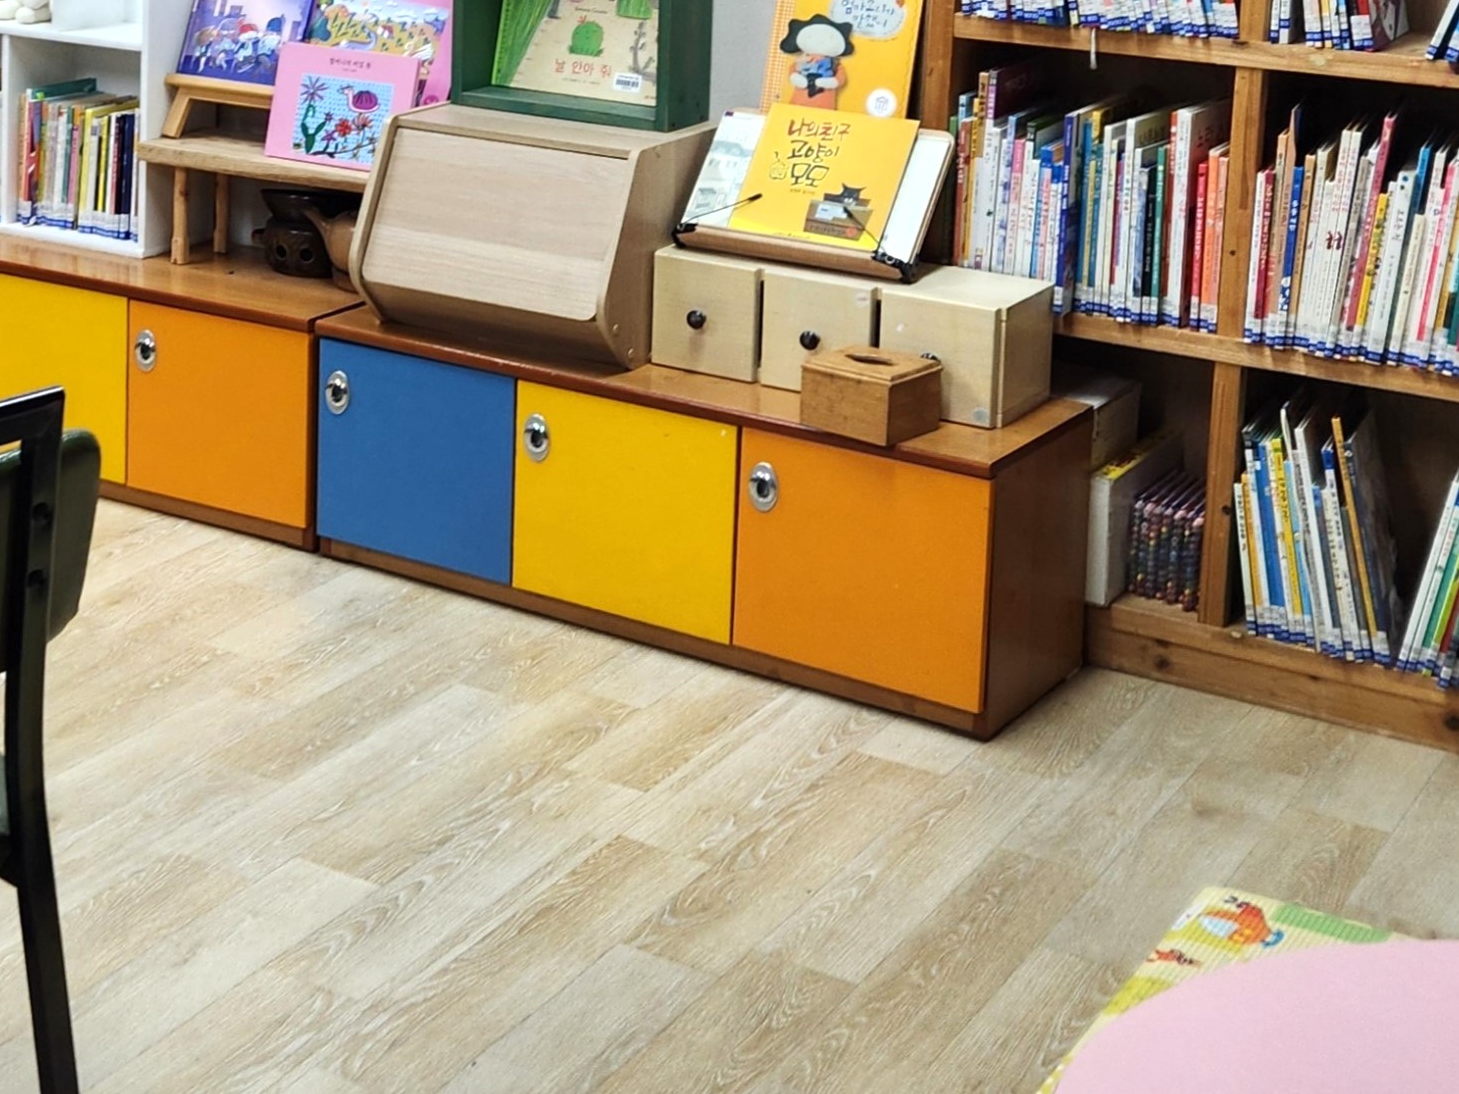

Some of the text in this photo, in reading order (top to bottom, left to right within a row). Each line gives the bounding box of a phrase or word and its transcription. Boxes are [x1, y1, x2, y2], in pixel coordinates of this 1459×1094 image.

[555, 59, 566, 73] 날
[571, 60, 595, 76] 안아
[787, 139, 840, 163] 고양이
[790, 162, 830, 187] 모모
